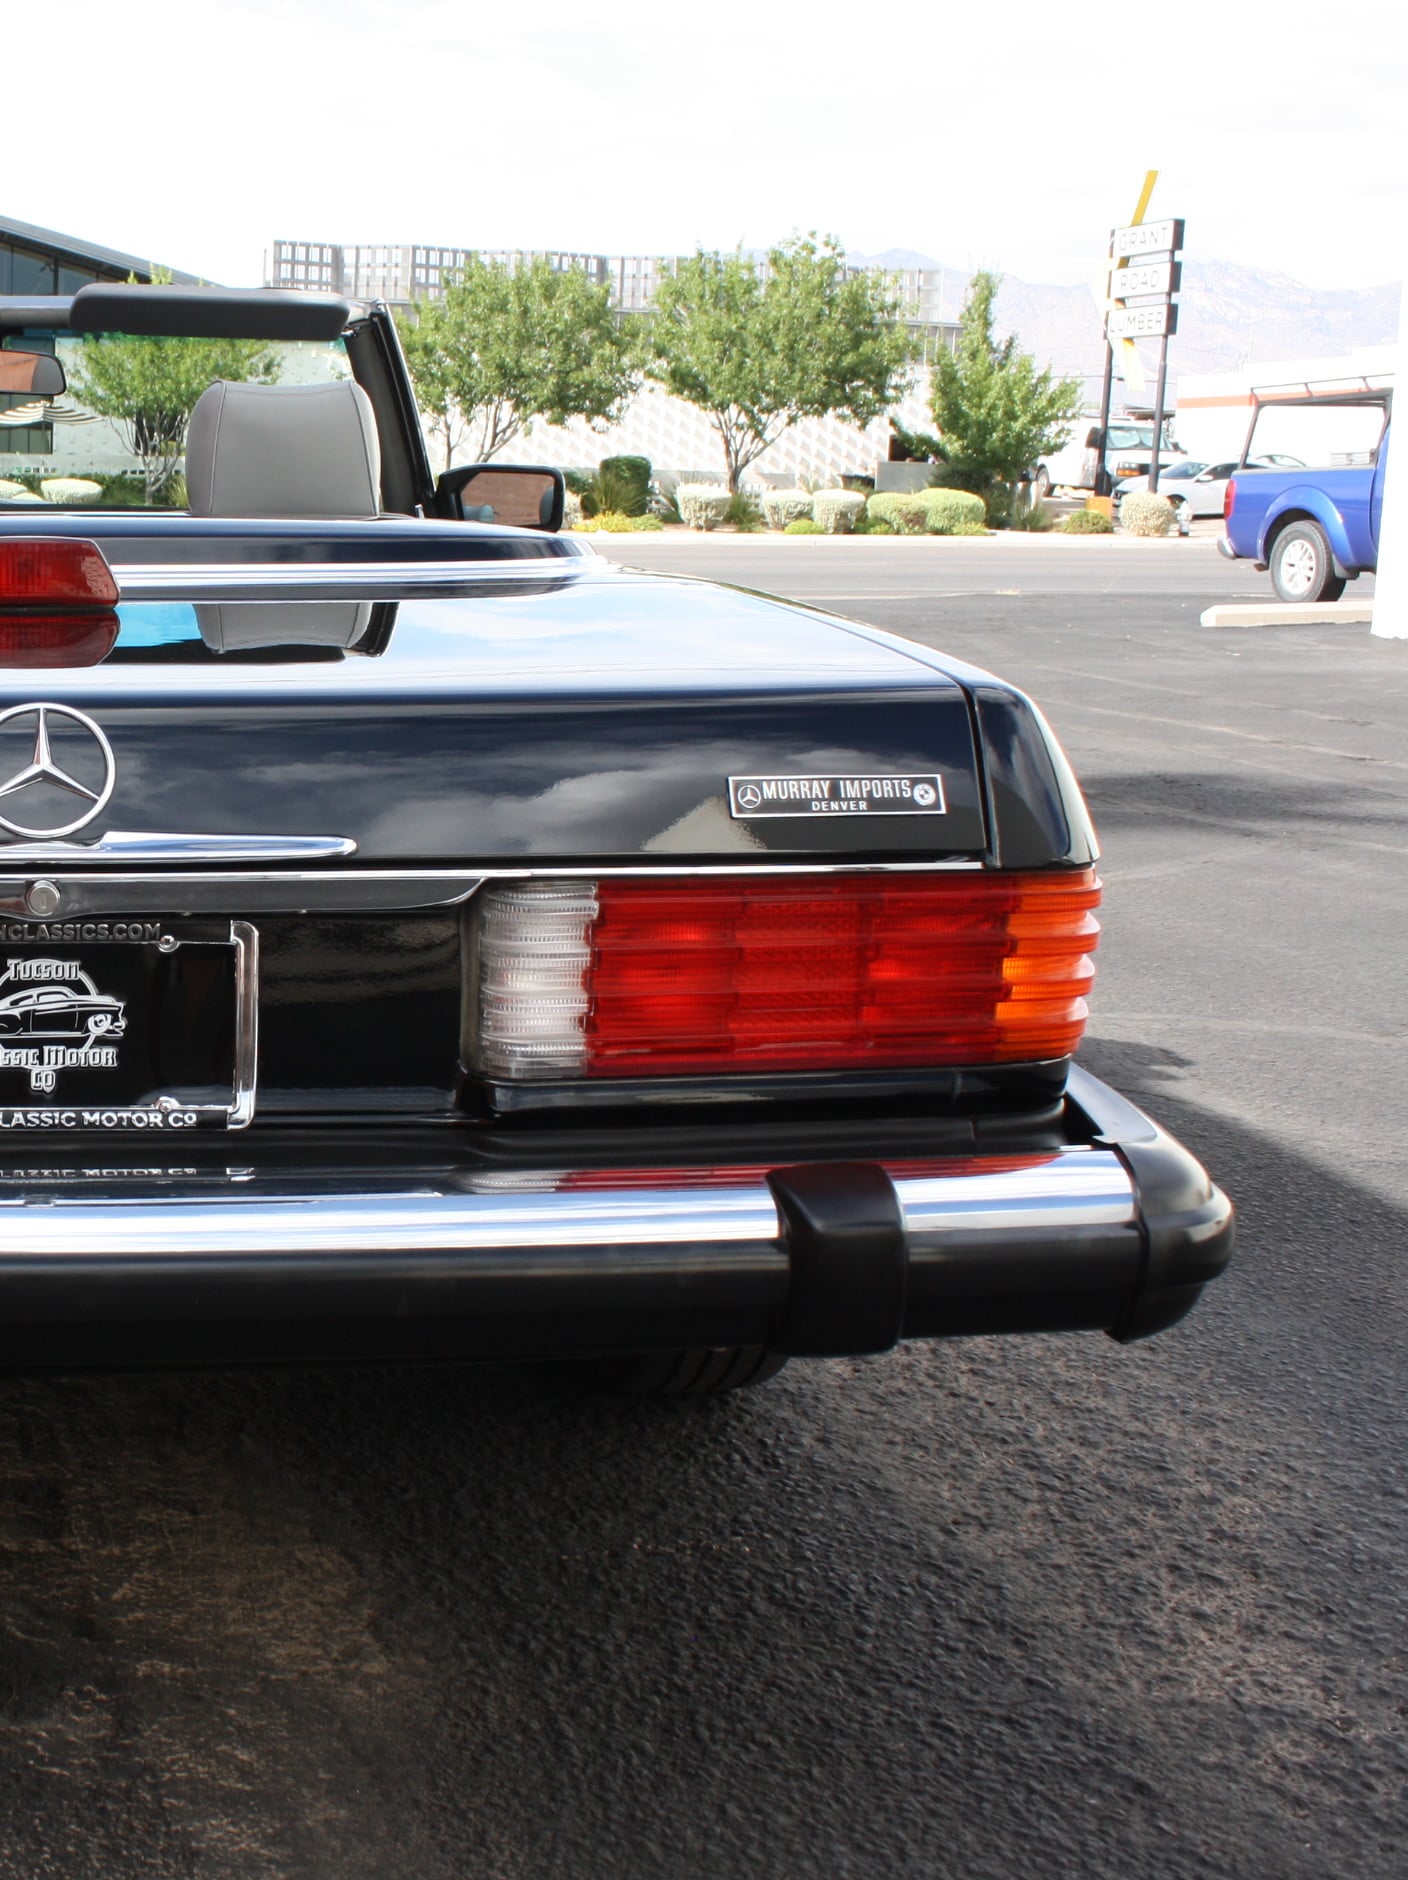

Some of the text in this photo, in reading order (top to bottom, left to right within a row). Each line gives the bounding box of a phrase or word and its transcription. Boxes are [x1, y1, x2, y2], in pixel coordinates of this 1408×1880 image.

[1118, 226, 1168, 251] GRANT
[1120, 270, 1160, 290] ROAD
[1109, 311, 1163, 333] LUMBER
[762, 779, 912, 800] MURRAY IMPORTS
[811, 801, 868, 811] DENVER
[7, 958, 81, 980] TUCSON
[42, 1045, 118, 1067] MOTOR
[83, 1112, 163, 1128] MOTOR
